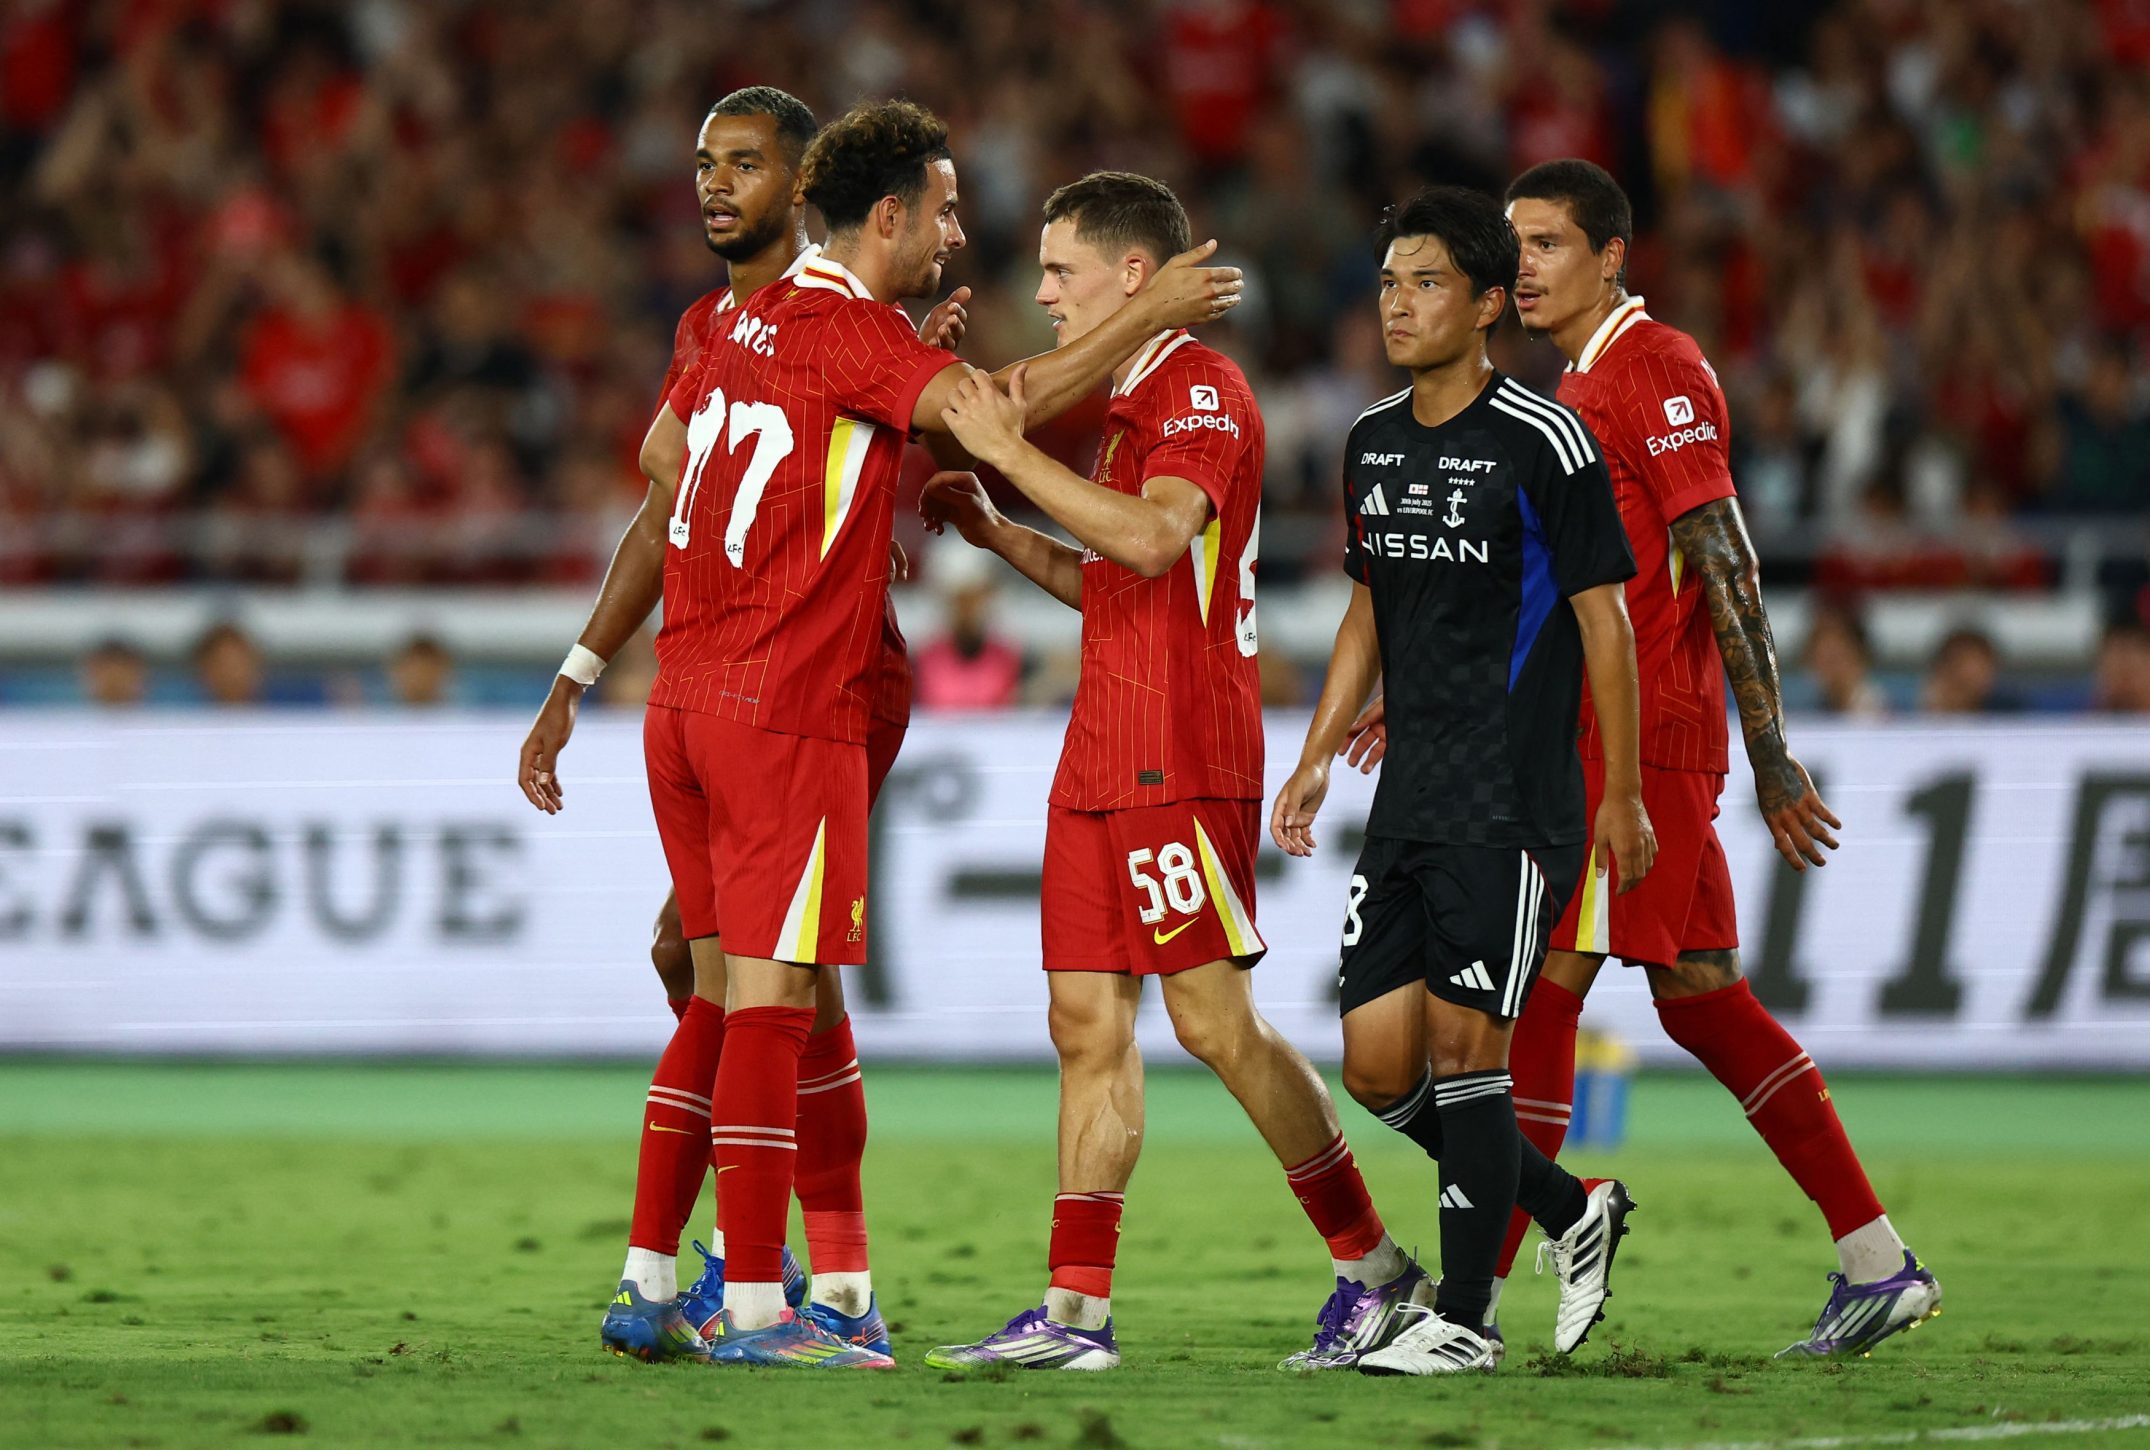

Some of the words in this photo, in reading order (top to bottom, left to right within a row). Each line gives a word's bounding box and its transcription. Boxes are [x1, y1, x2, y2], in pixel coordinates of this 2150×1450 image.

[1361, 452, 1406, 467] DRAFT
[1438, 457, 1497, 474] DRAFT
[1127, 841, 1207, 925] 58
